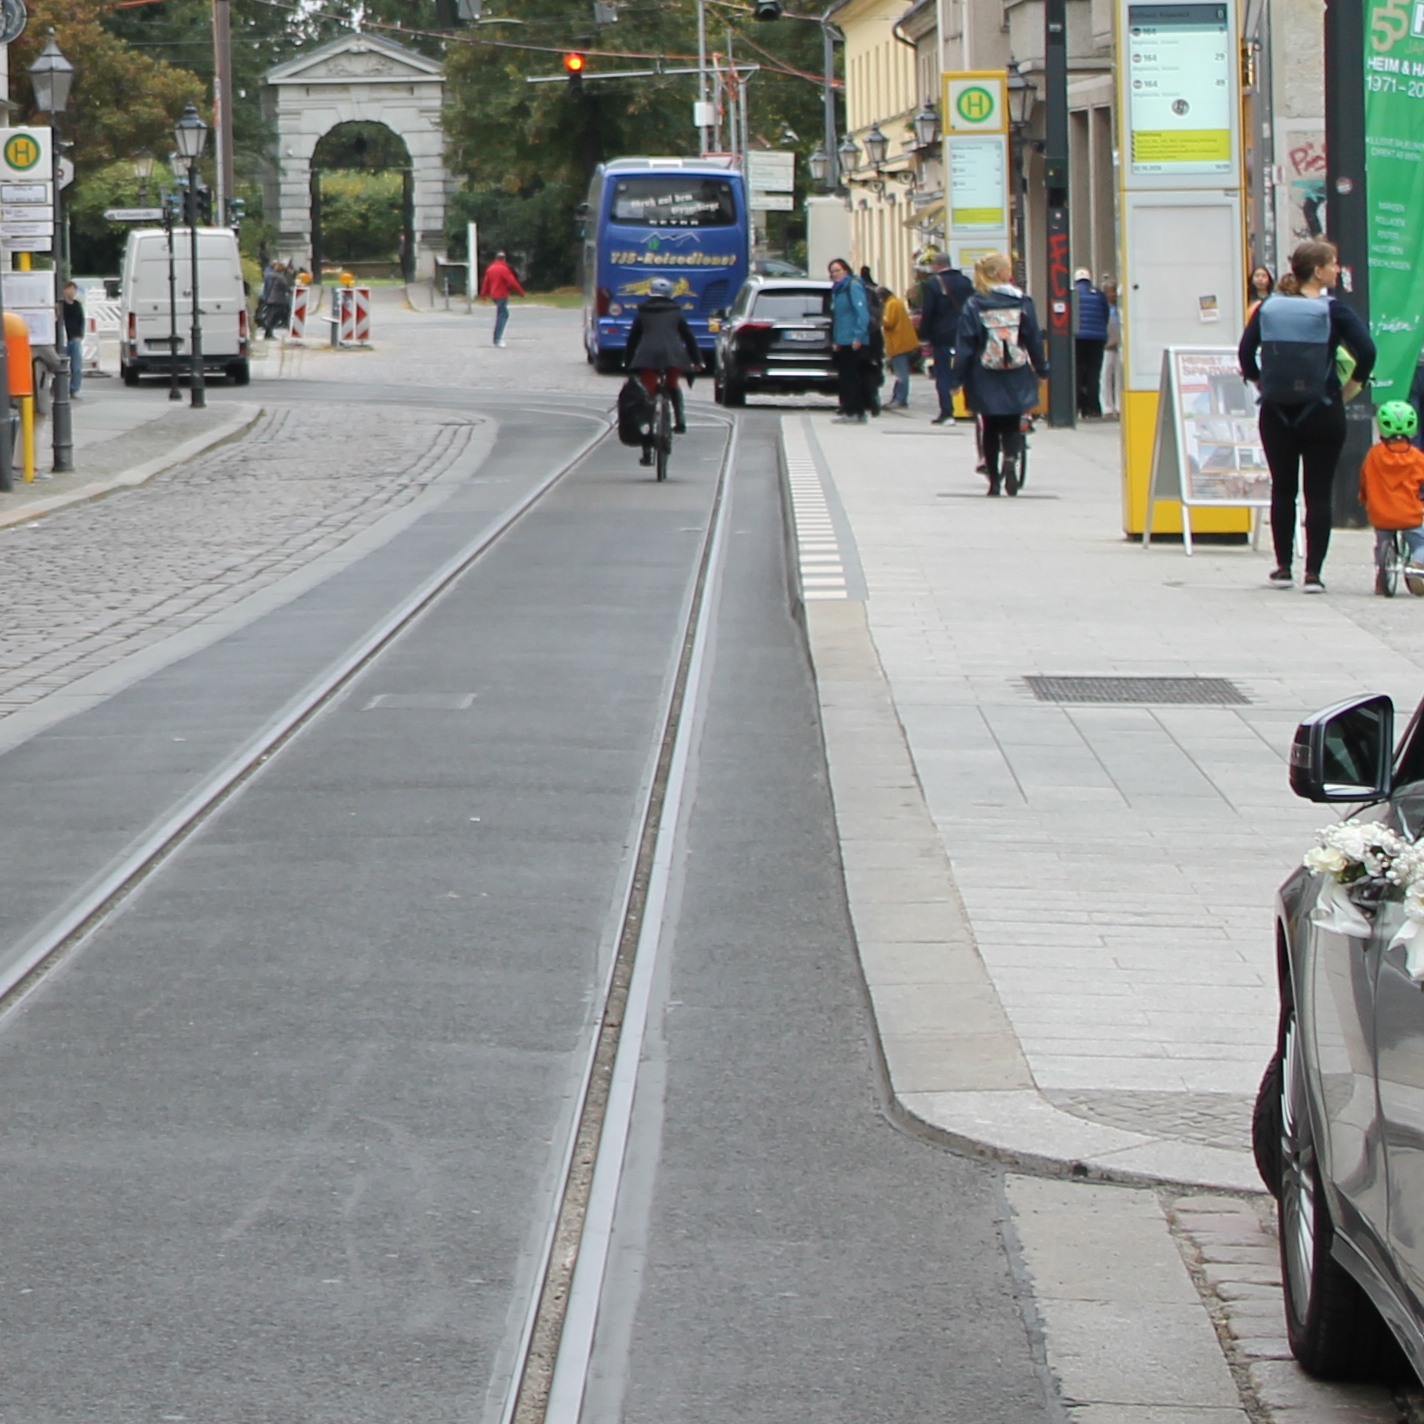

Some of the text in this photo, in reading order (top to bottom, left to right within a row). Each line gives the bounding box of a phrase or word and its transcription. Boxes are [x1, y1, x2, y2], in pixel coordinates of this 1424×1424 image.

[1367, 56, 1400, 73] HEIM
[1401, 60, 1410, 76] &
[967, 94, 983, 115] H
[15, 142, 29, 163] H
